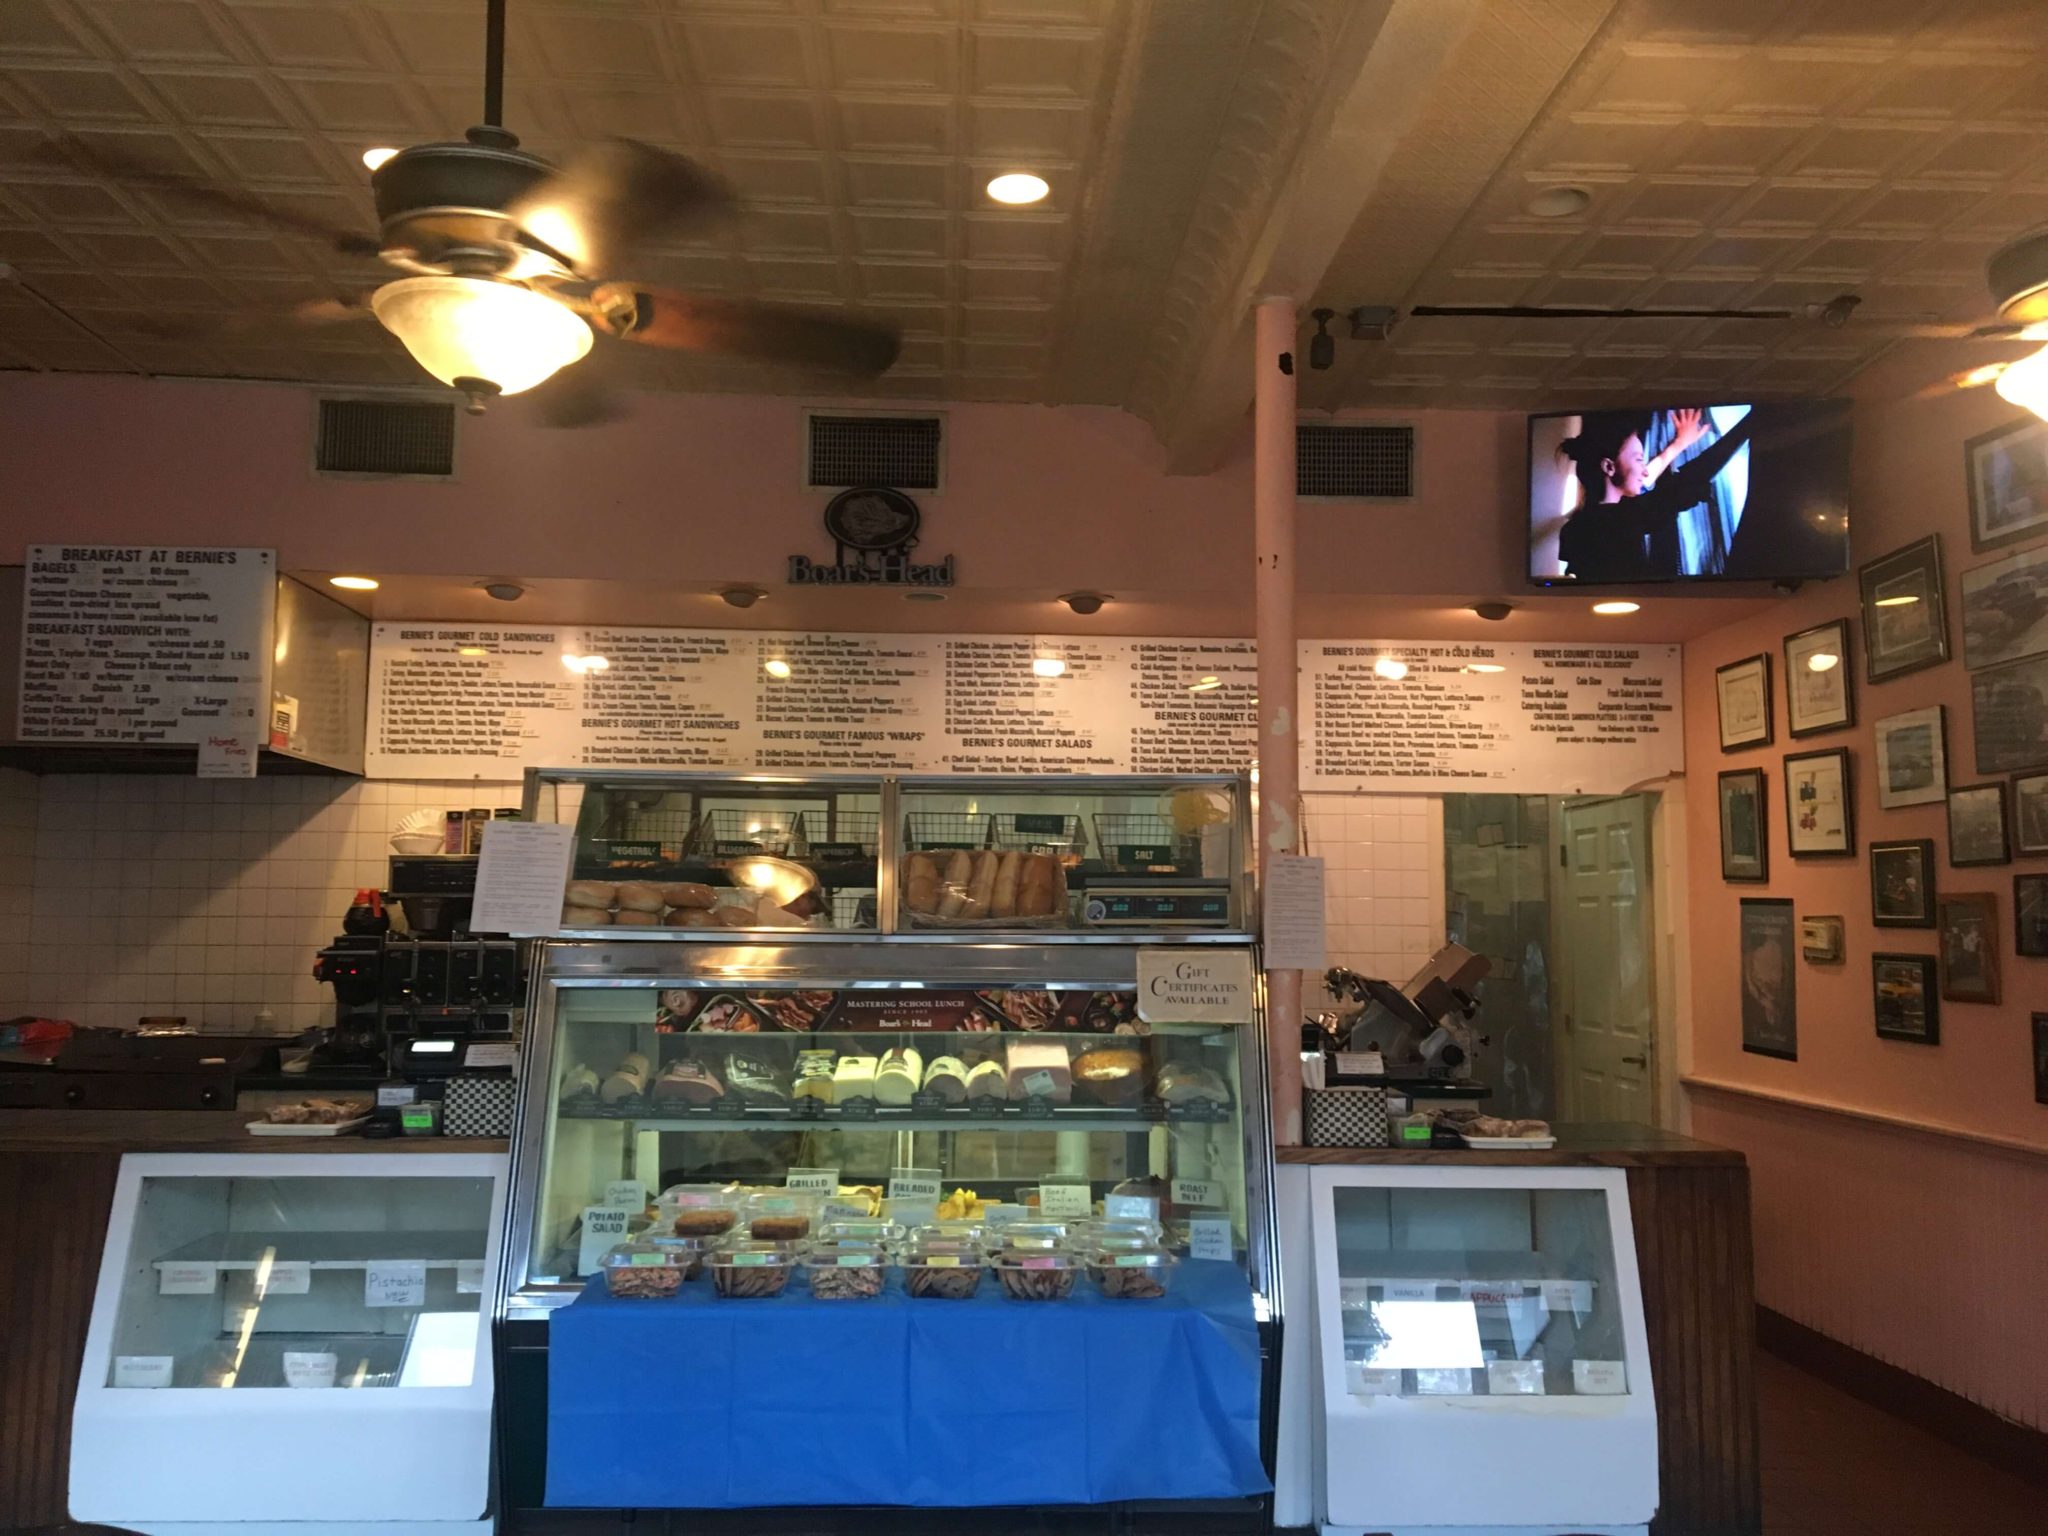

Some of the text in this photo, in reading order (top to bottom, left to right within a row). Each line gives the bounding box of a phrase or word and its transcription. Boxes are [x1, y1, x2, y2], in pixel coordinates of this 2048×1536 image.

[62, 548, 237, 564] BREAKFAST AT BERNIE'S
[788, 554, 954, 585] Boar's Head
[27, 624, 95, 635] BREAKFAST
[97, 626, 162, 636] SANDWICH
[401, 631, 555, 642] BERNIE'S GOURMET COLD SANDWICHES
[1323, 647, 1353, 656] BERNIE'S
[1392, 648, 1428, 657] SPECIALTY
[1430, 648, 1444, 657] HOT
[1452, 648, 1470, 657] COLD
[1472, 648, 1495, 658] HEROS
[1534, 649, 1639, 659] BERNIE'S GOURMET COLD SALADS
[1155, 712, 1196, 721] BERNIE'S
[1199, 713, 1244, 721] GOURMET
[582, 719, 740, 729] BERNIE'S GOURMET HOT SANDWICHES
[763, 730, 925, 741] BERNIE'S GOURMET FAMOUS "WRAPS"
[962, 738, 1092, 748] BERNIE'S GOURMET SALADS
[1135, 851, 1154, 860] SALT
[1176, 962, 1210, 980] GIFT
[1151, 976, 1238, 997] CERTIFICATES
[847, 1000, 897, 1008] MASTERING
[879, 1019, 932, 1027] Boar's Head
[789, 1179, 828, 1188] GRILLED
[893, 1183, 935, 1193] BREADED
[1179, 1184, 1208, 1193] ROAST
[1181, 1193, 1206, 1202] BEEF
[588, 1212, 625, 1221] POTATO
[592, 1223, 623, 1233] SALAD
[369, 1272, 424, 1290] Pistachio
[1393, 1290, 1425, 1298] VANILLA
